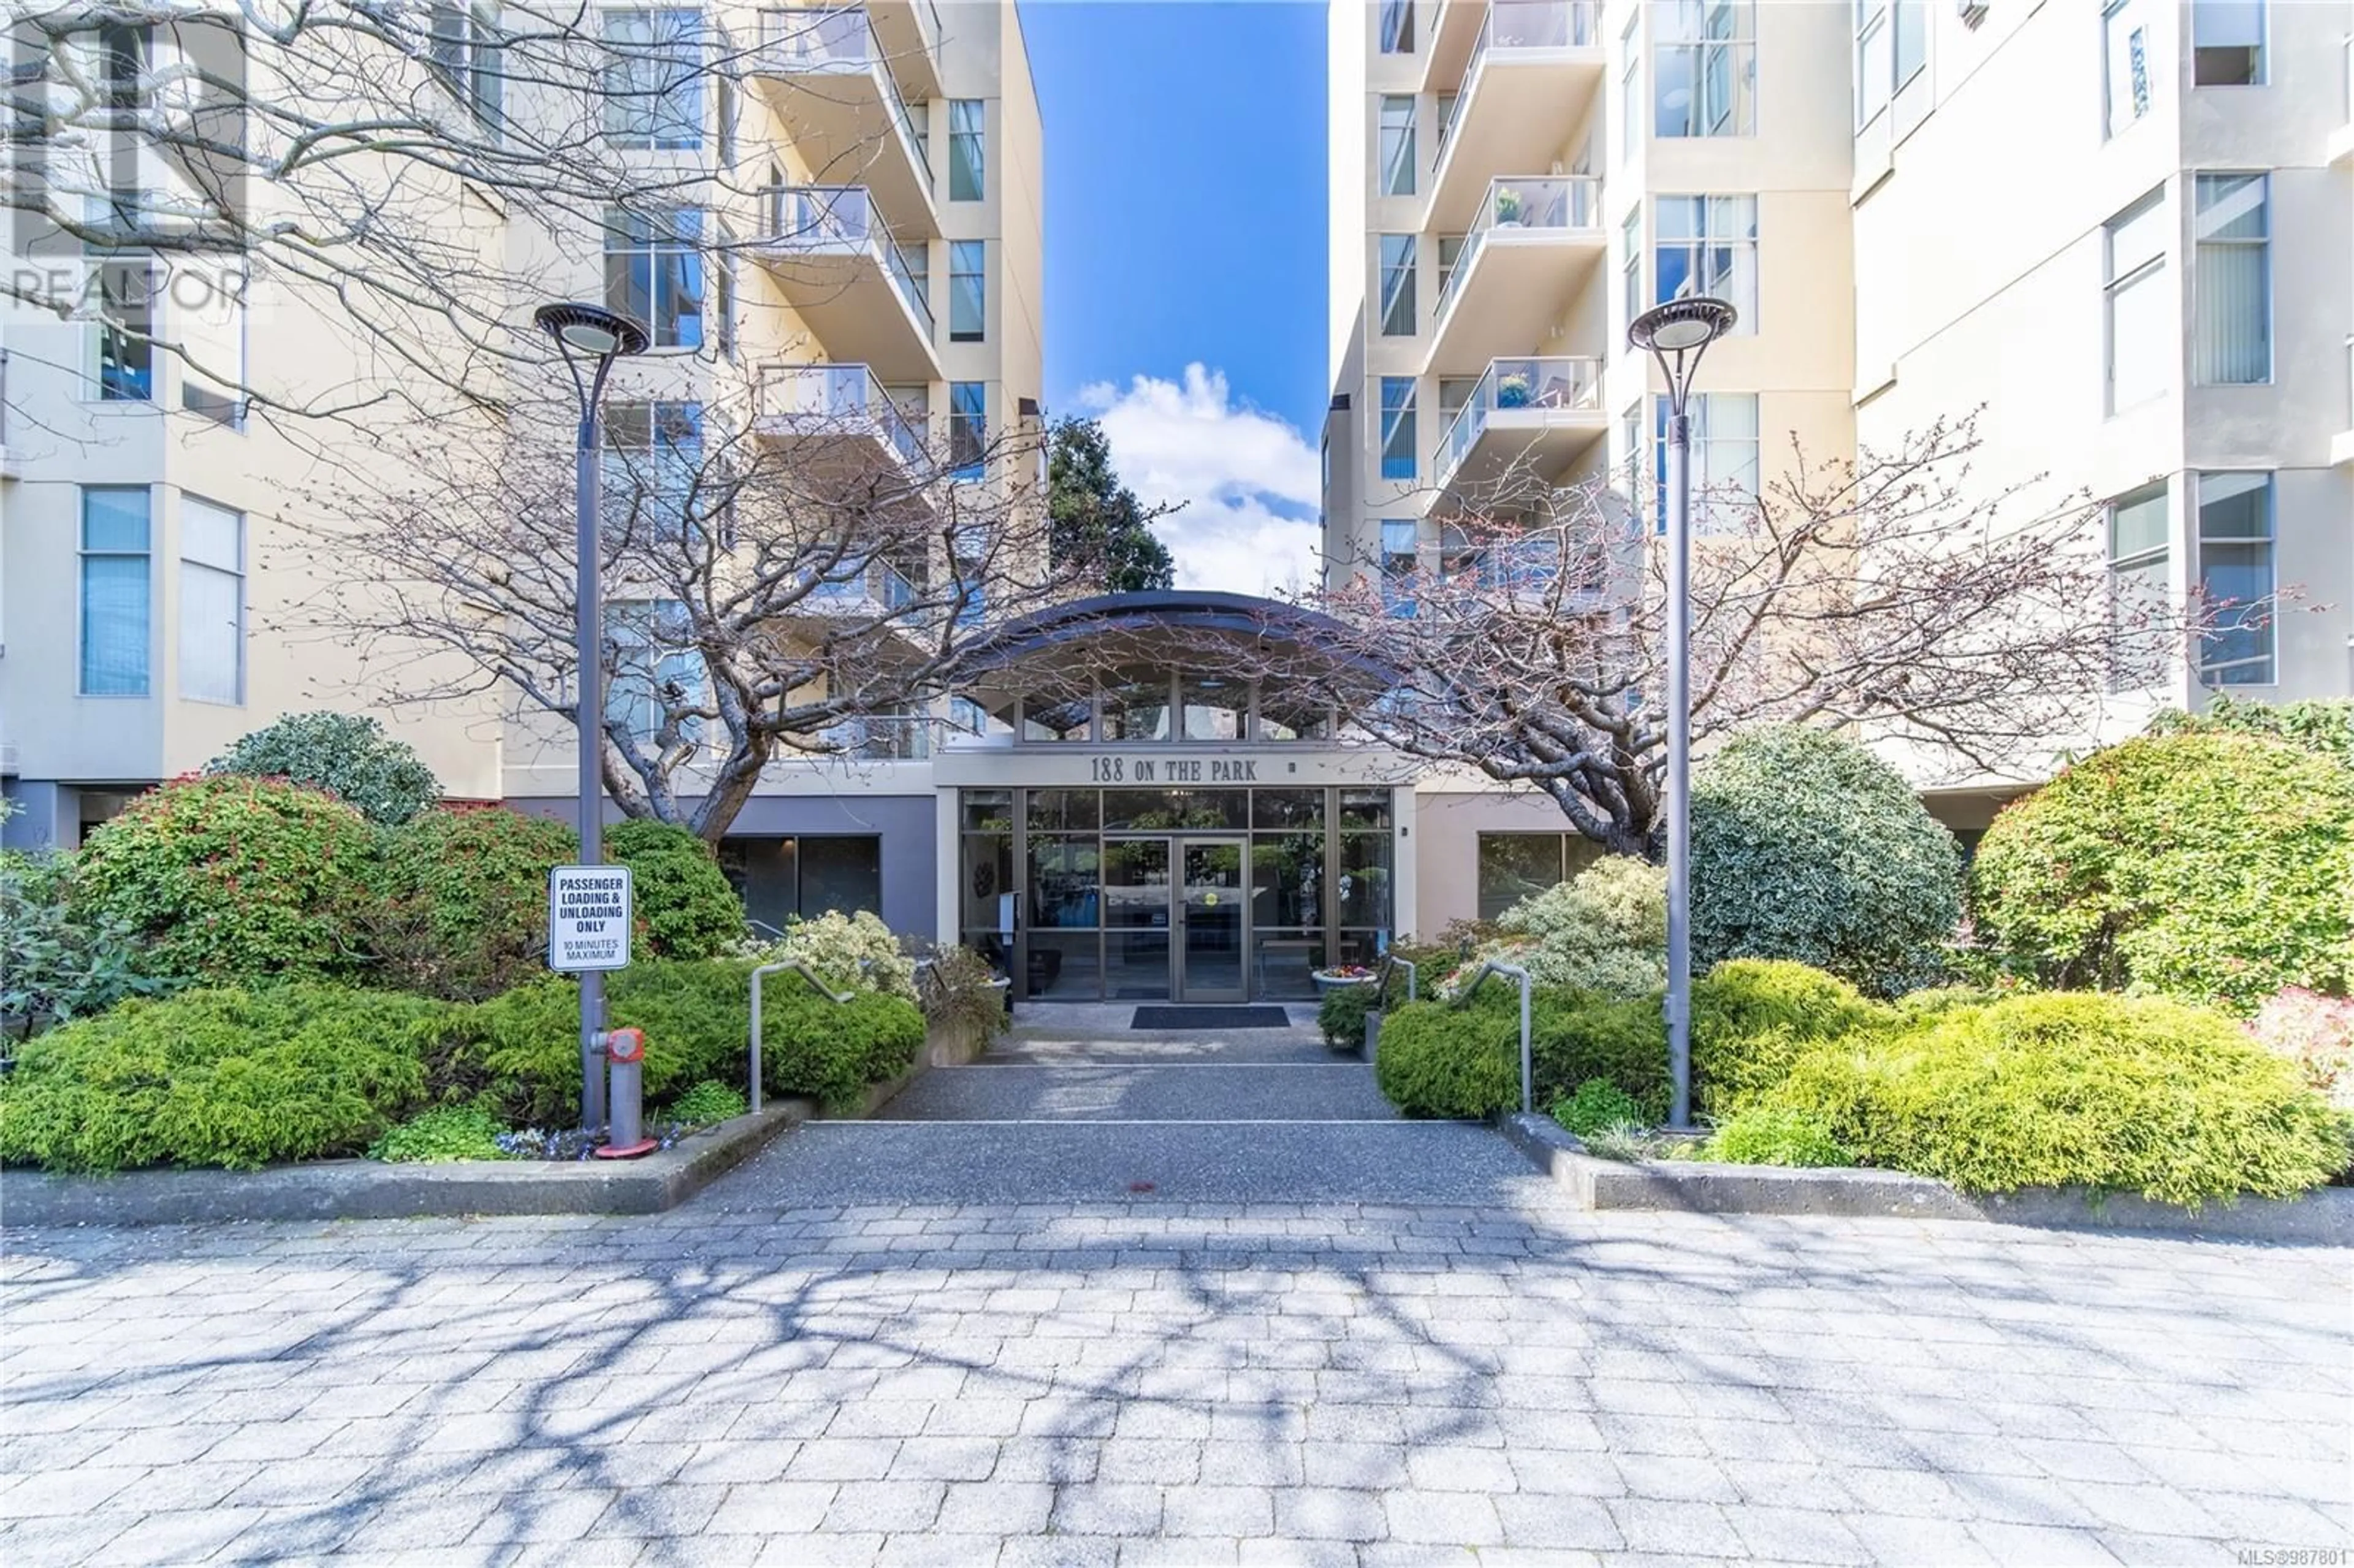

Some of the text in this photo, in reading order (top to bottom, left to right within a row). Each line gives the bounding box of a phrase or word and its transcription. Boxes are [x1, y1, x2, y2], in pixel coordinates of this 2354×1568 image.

[1092, 757, 1257, 782] 188 ON THE PARK
[560, 878, 623, 891] PASSENGER
[562, 892, 620, 904] LOADING &
[560, 906, 622, 918] UNLOADING
[577, 921, 605, 932] ONLY
[564, 940, 619, 950] 10 MINUTES
[566, 951, 615, 959] MAXIMUM
